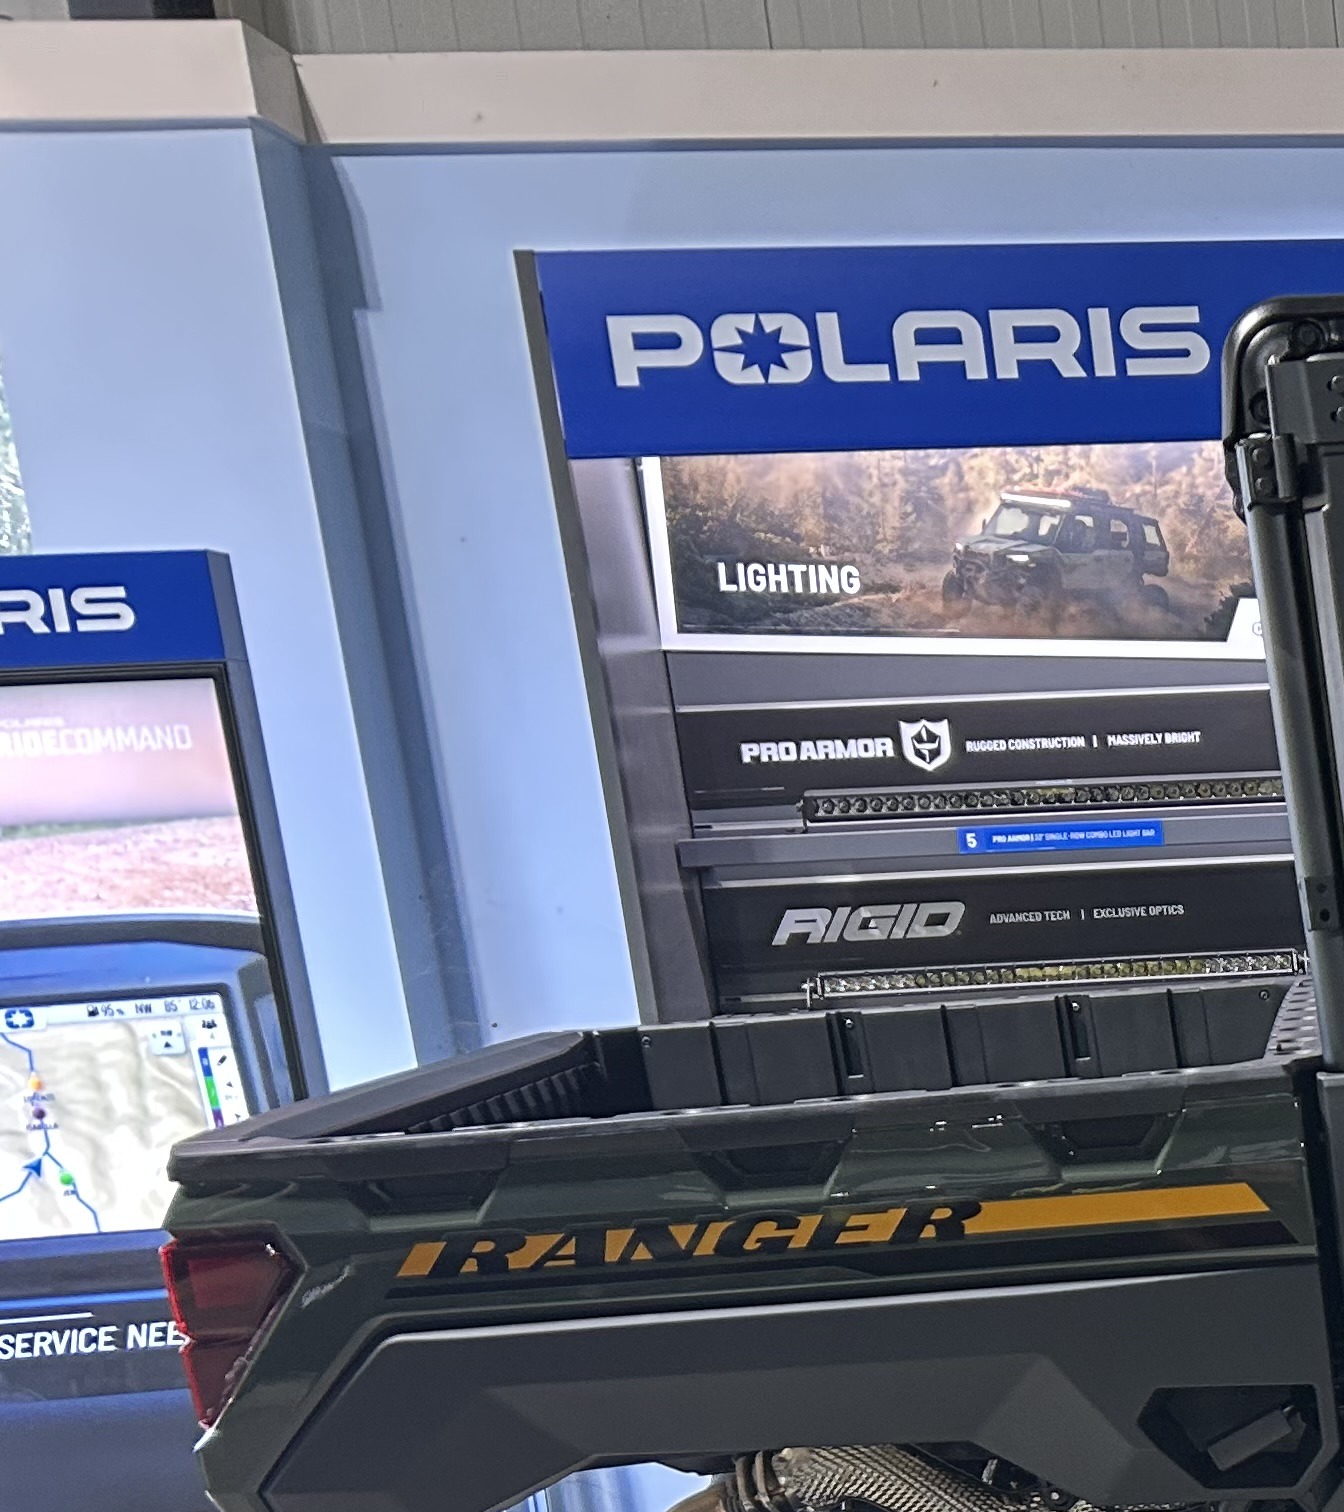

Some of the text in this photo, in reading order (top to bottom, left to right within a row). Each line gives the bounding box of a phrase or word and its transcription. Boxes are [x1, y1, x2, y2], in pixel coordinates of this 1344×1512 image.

[606, 305, 1211, 387] POLARIS
[717, 561, 861, 595] LIGHTING
[741, 731, 1201, 763] PRO ARMOR RUGGED CONSTRUCTION MASSIVELY BRIGHT
[965, 832, 978, 848] 5
[772, 901, 1185, 946] RIGID ADVANCED TECH EXCLUSIVE OPTICS
[427, 1200, 982, 1278] RANGER
[0, 1326, 119, 1360] SERVICE
